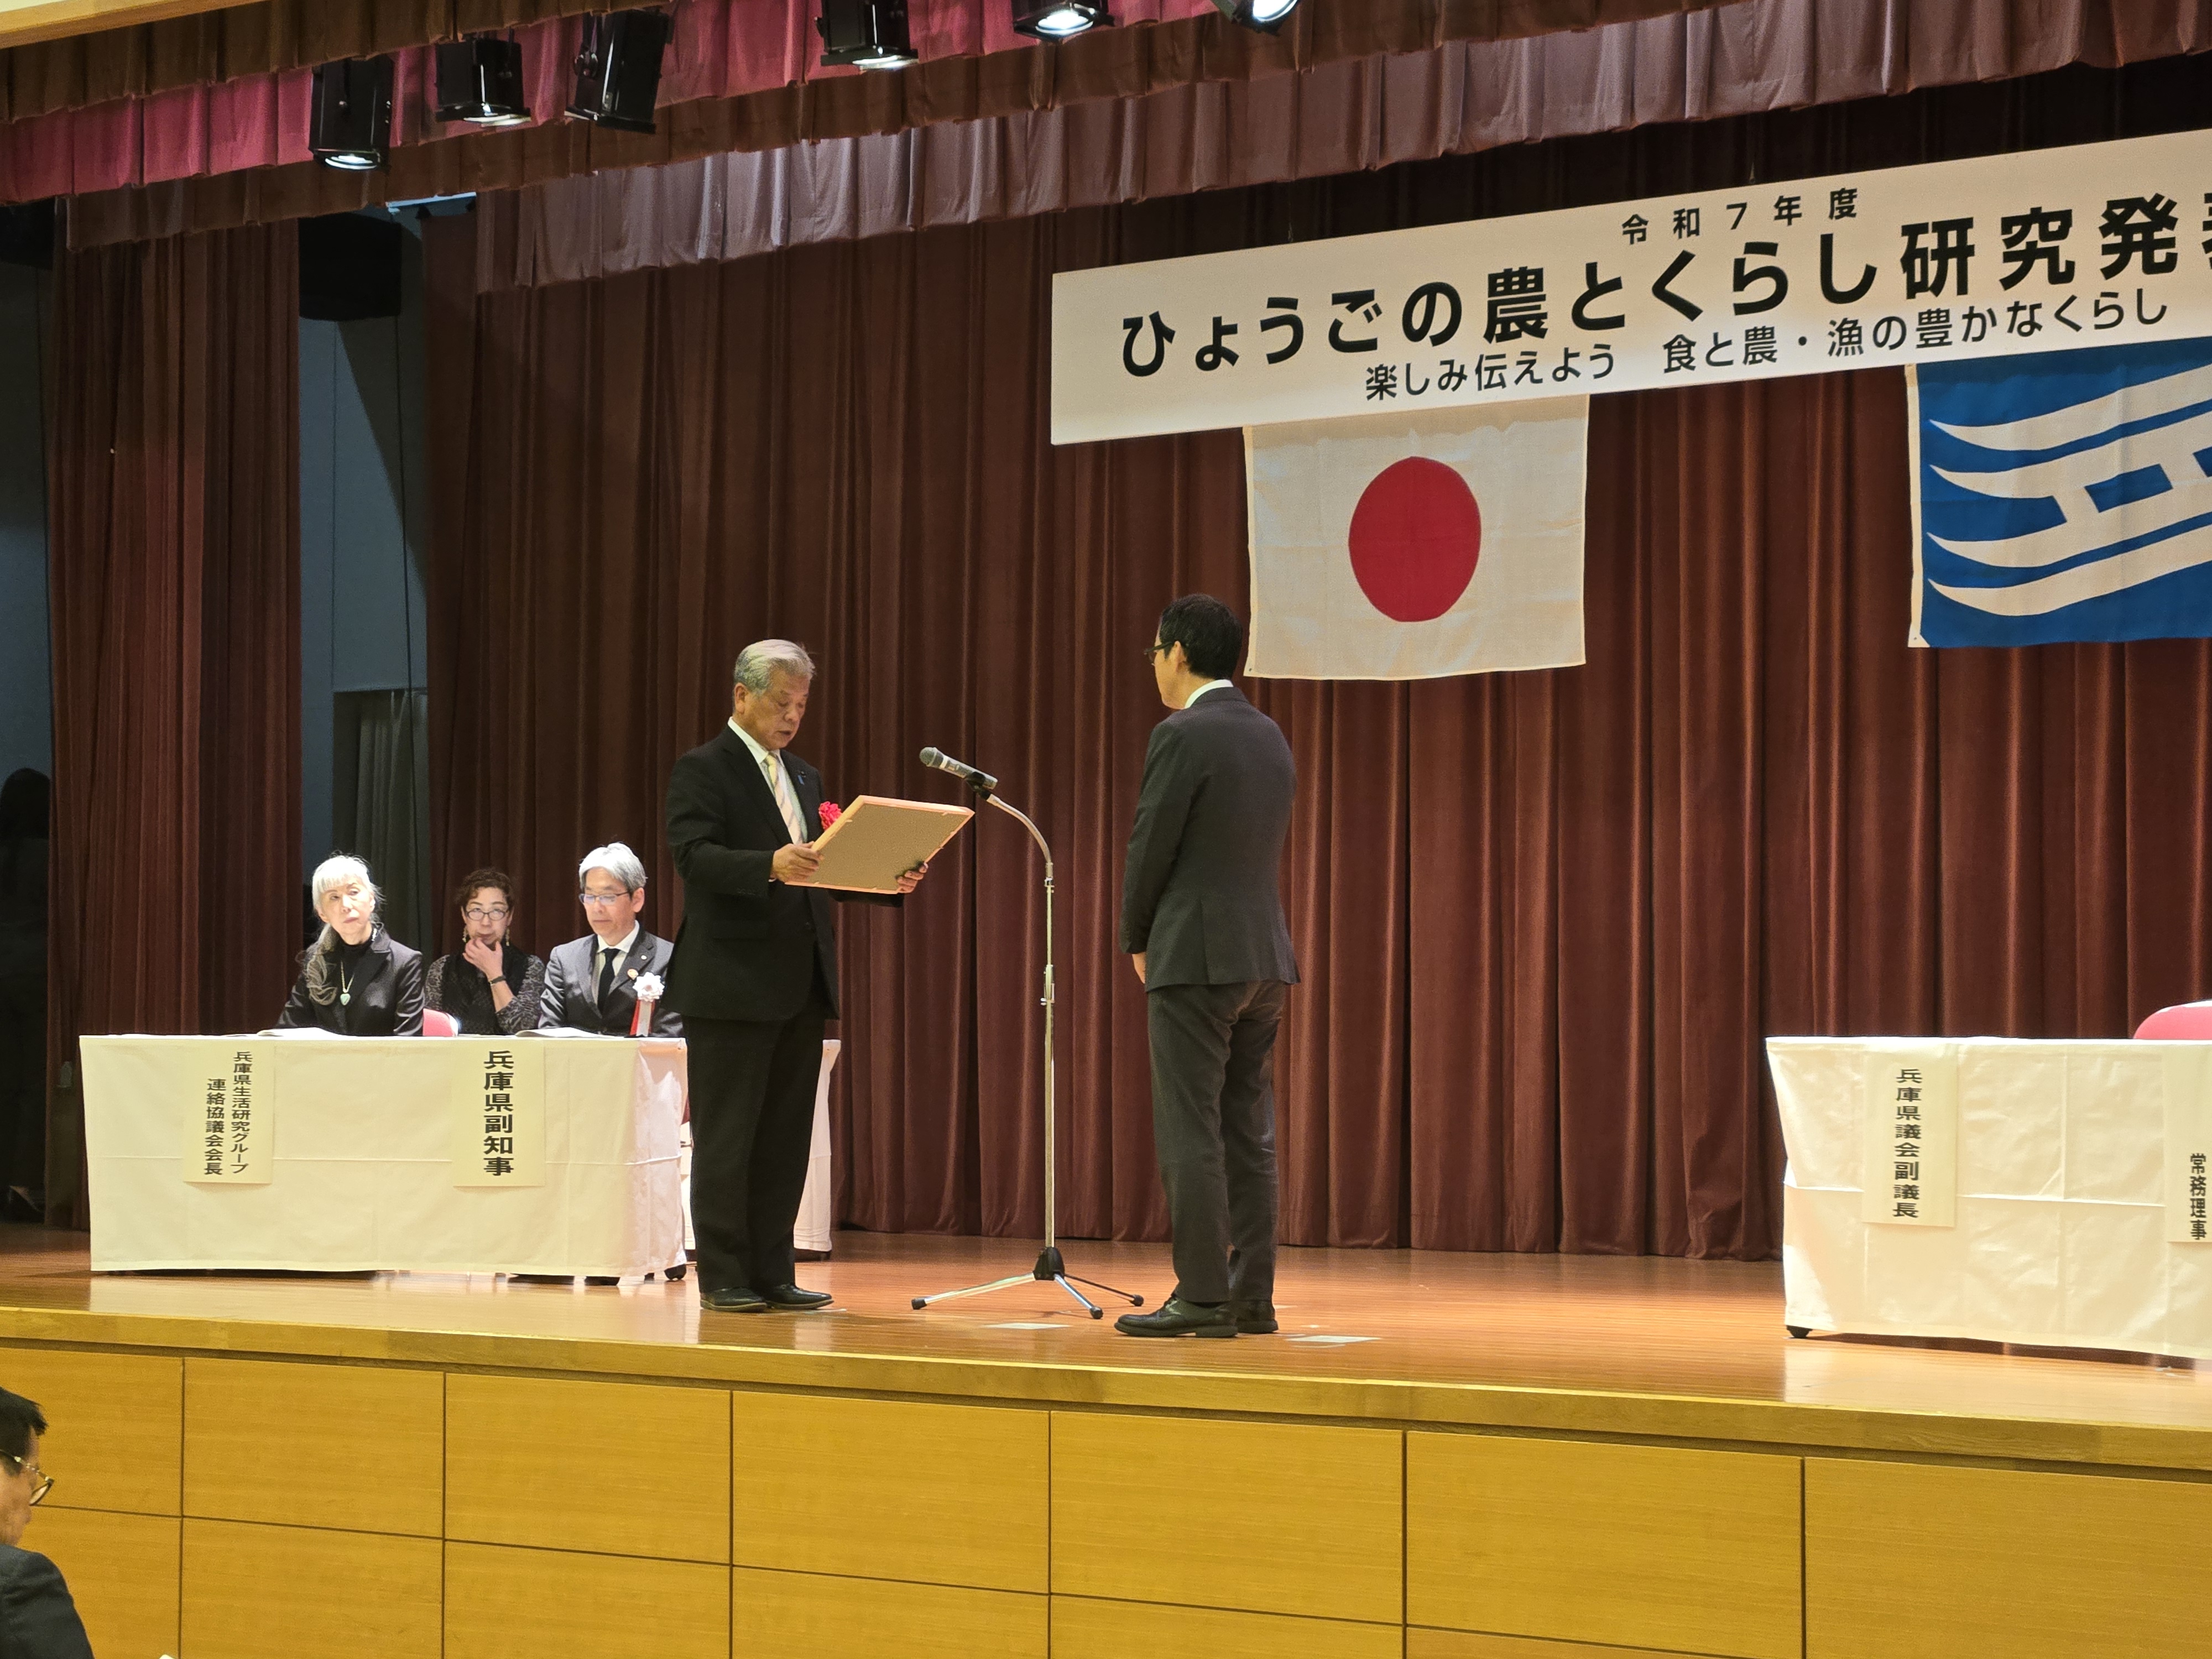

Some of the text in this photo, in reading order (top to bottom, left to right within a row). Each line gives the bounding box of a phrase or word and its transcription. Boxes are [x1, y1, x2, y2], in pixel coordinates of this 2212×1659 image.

[1621, 187, 1858, 246] 令和7年度
[1122, 192, 2212, 378] ひょうごの農とくらし研究発
[1365, 288, 2168, 401] 楽しみ伝えよう 食と農・漁の豊かなくらし
[204, 1078, 227, 1176] 連絡協議会会長
[230, 1051, 253, 1174] 兵庫県生活研究グループ
[483, 1050, 515, 1176] 兵庫県副知事
[1892, 1068, 1923, 1218] 兵庫県議会副議長
[2190, 1152, 2207, 1240] 常務理事
